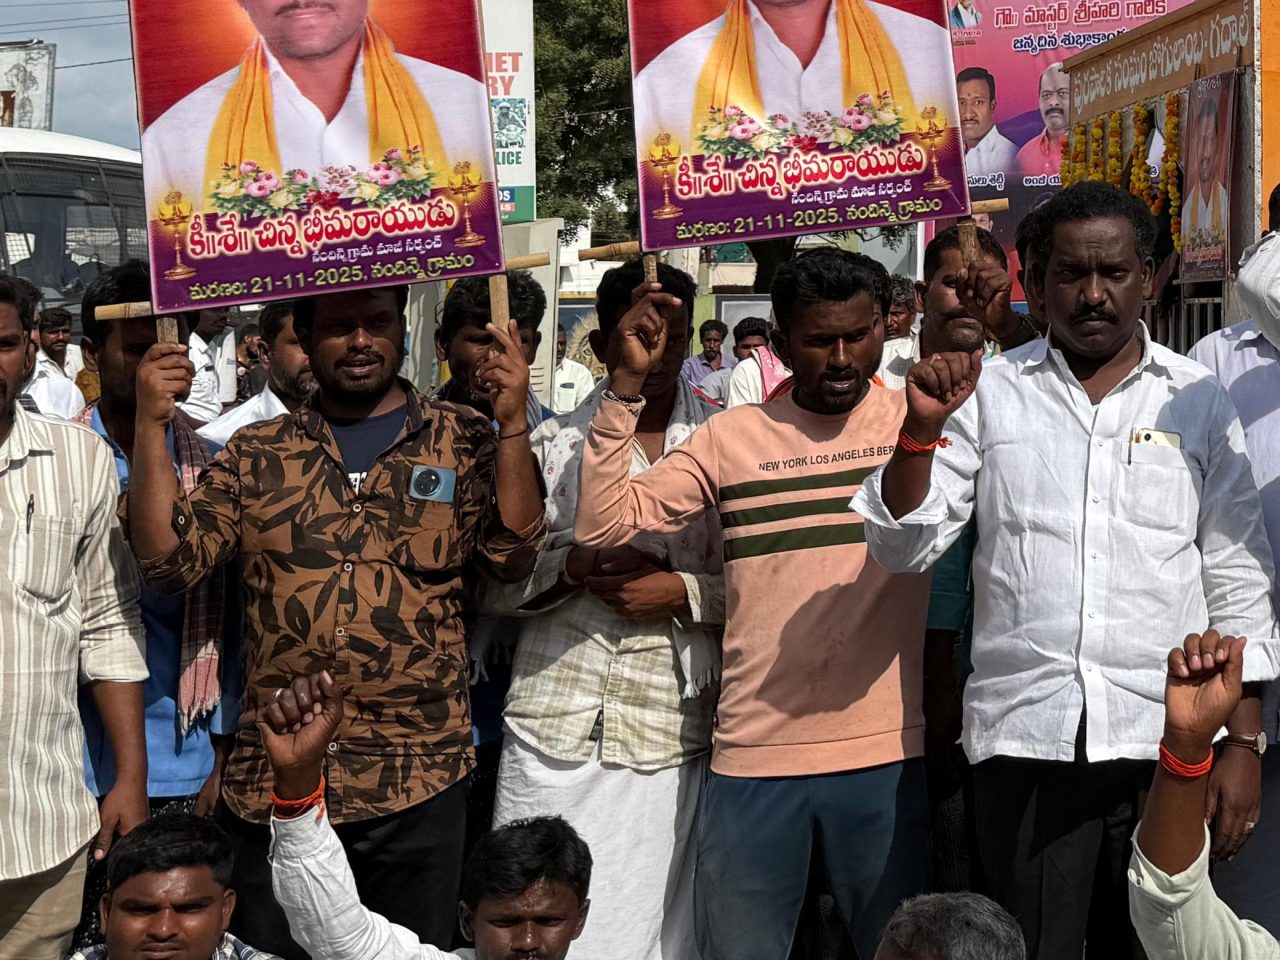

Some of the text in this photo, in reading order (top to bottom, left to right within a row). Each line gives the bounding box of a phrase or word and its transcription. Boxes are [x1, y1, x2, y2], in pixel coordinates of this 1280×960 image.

[739, 156, 782, 196] చిన్న
[783, 143, 924, 189] భీమరాయుడు
[255, 214, 304, 255] చిన్న
[304, 198, 456, 248] భీమరాయుడు
[734, 208, 842, 233] 21-11-2025,
[898, 197, 942, 220] గ్రామం
[251, 267, 367, 294] 21-11-2025,
[427, 252, 474, 277] గ్రామం
[759, 461, 780, 471] NEW
[782, 456, 807, 469] YORK
[810, 454, 829, 465] LOS
[831, 448, 875, 463] ANGELES
